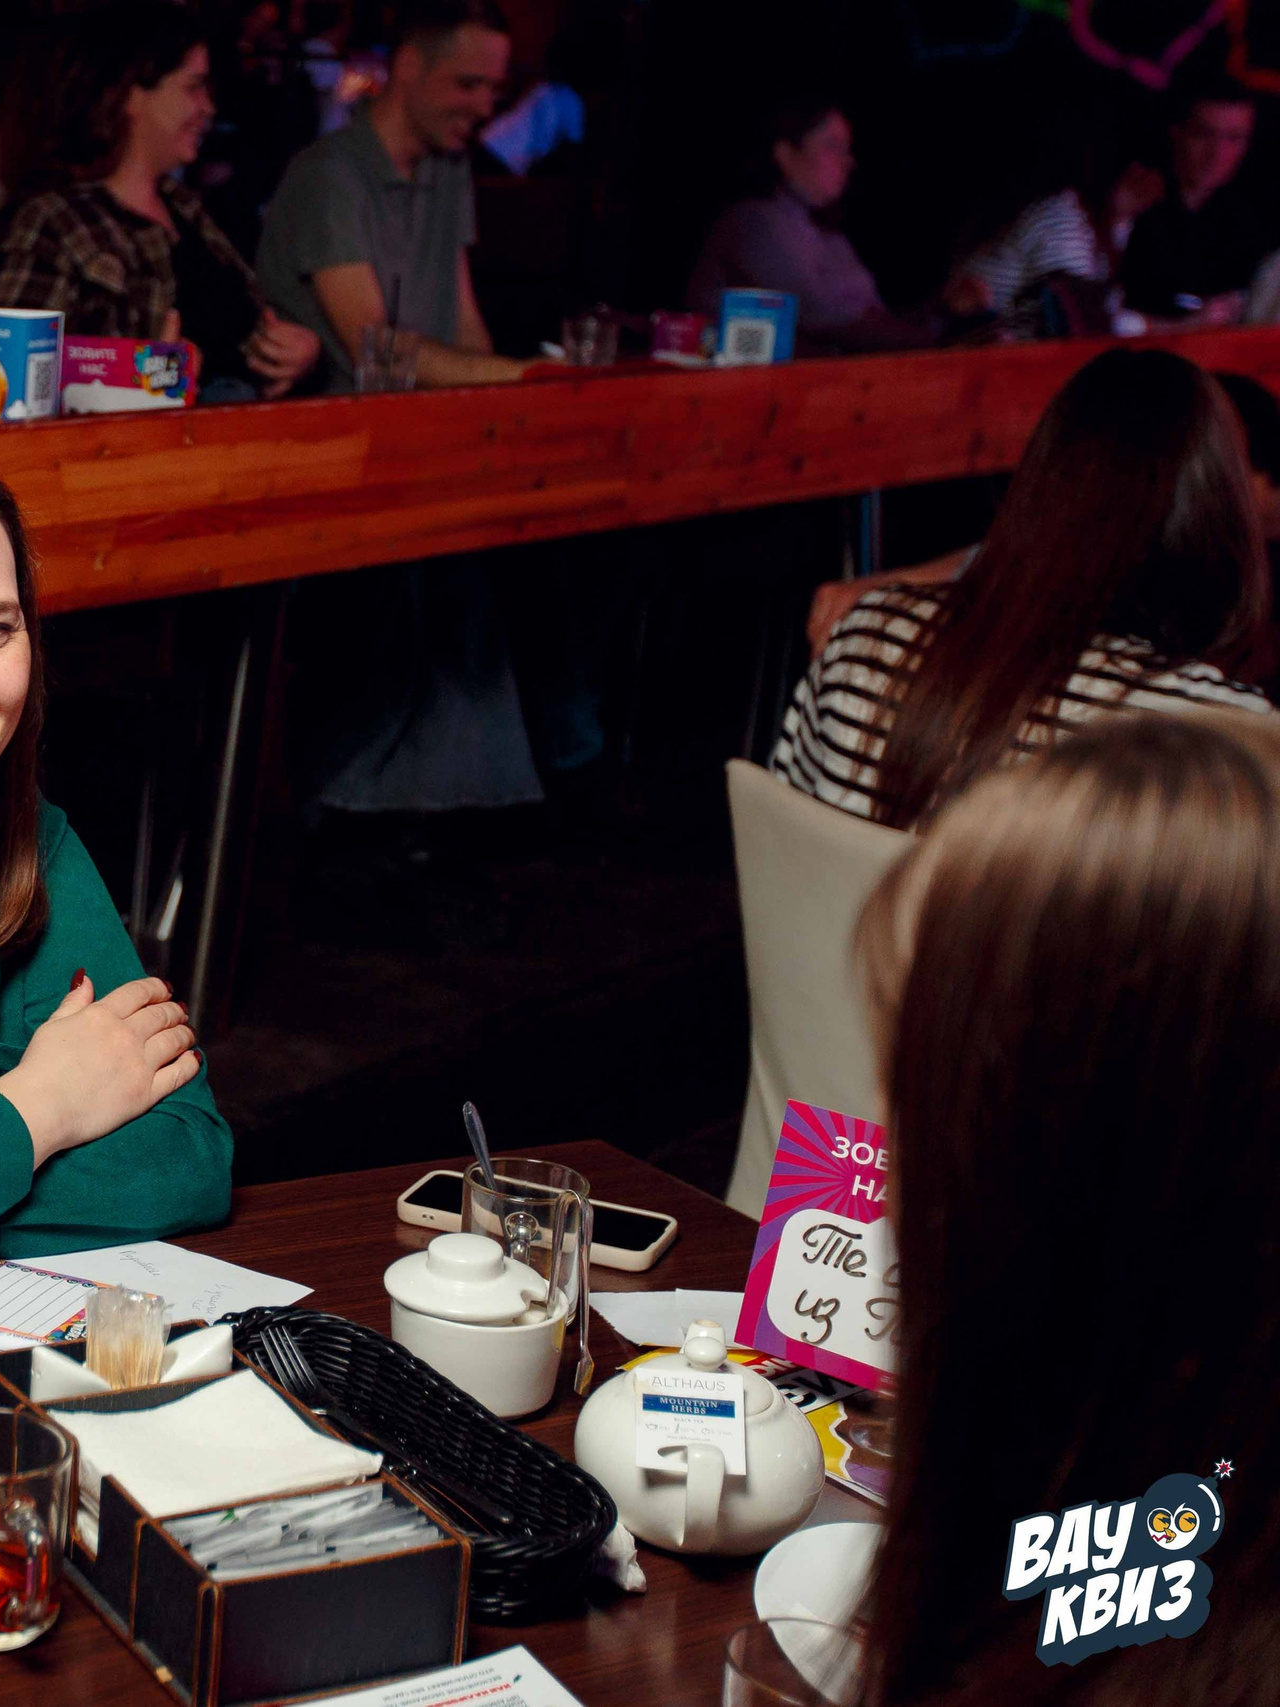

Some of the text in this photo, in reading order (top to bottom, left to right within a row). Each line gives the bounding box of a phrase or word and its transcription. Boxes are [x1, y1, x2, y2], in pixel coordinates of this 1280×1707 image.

[652, 1376, 726, 1391] ALTHAUS
[660, 1397, 718, 1409] MOUNTAIN
[671, 1405, 707, 1415] HERBS
